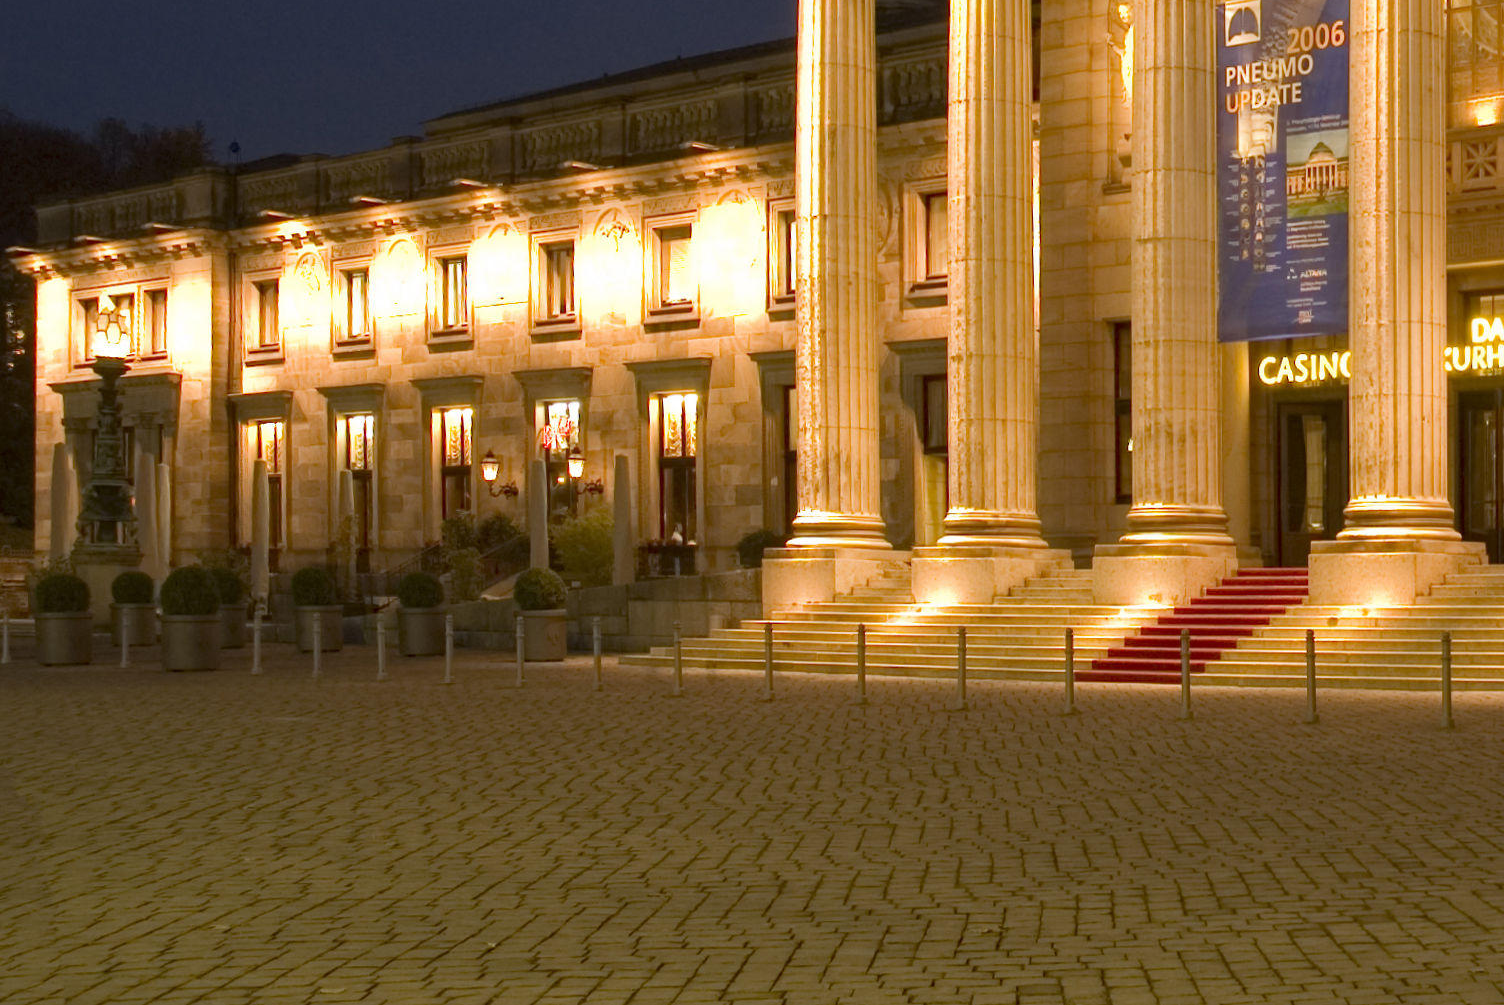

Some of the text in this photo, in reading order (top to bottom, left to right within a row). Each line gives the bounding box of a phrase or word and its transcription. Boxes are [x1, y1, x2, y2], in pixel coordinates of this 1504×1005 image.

[1287, 20, 1345, 54] 2006
[1226, 54, 1314, 87] PNEUMO
[1226, 82, 1302, 114] UPDATE
